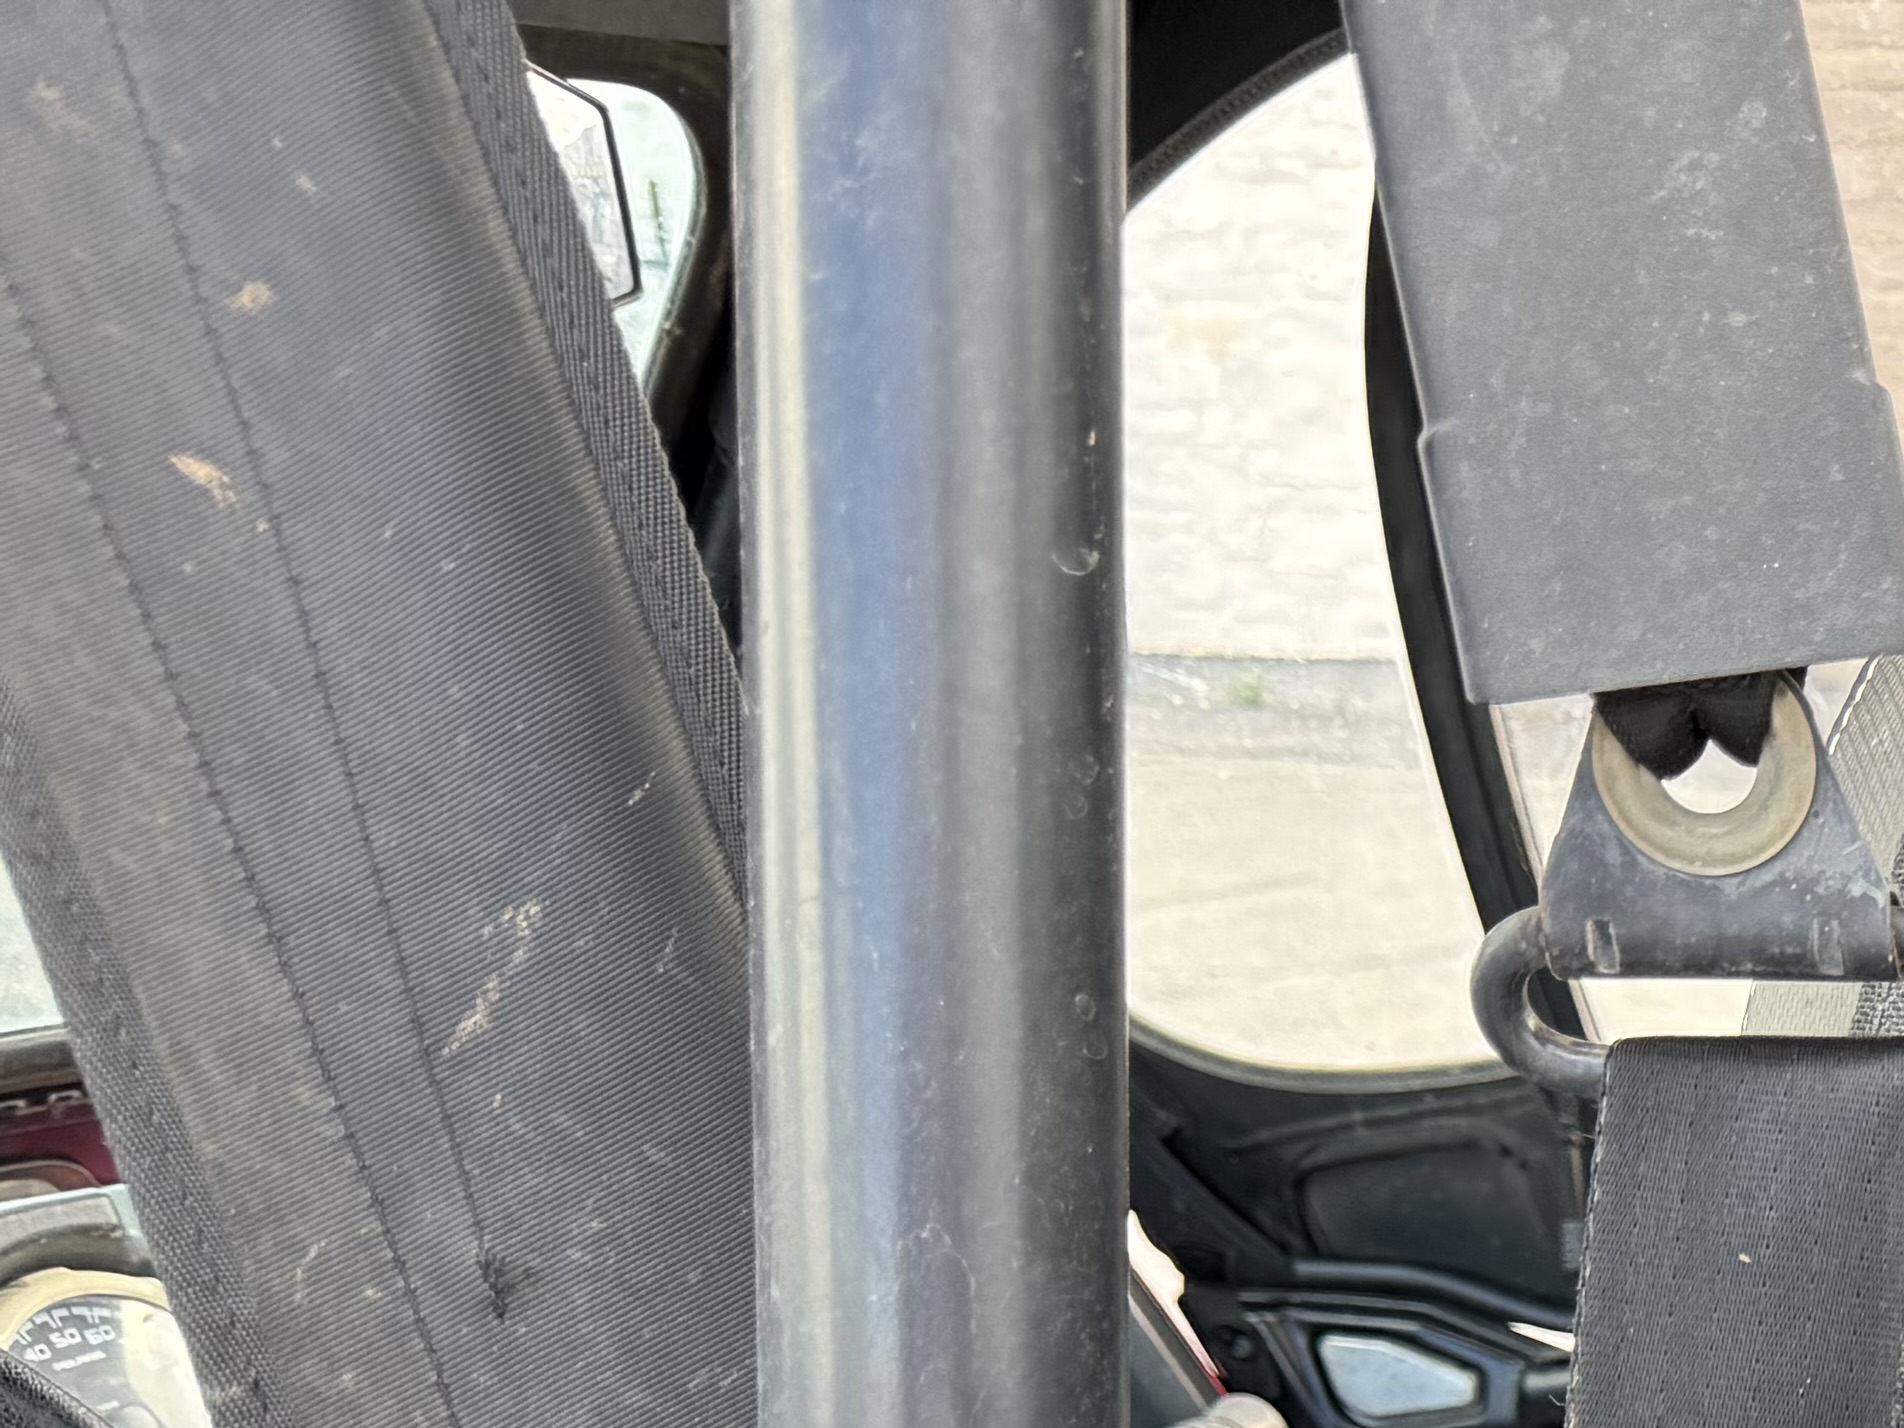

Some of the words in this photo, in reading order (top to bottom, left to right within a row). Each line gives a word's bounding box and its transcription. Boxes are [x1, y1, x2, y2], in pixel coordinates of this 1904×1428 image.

[48, 1327, 83, 1349] 50
[83, 1324, 116, 1345] 60
[23, 1343, 52, 1362] 40
